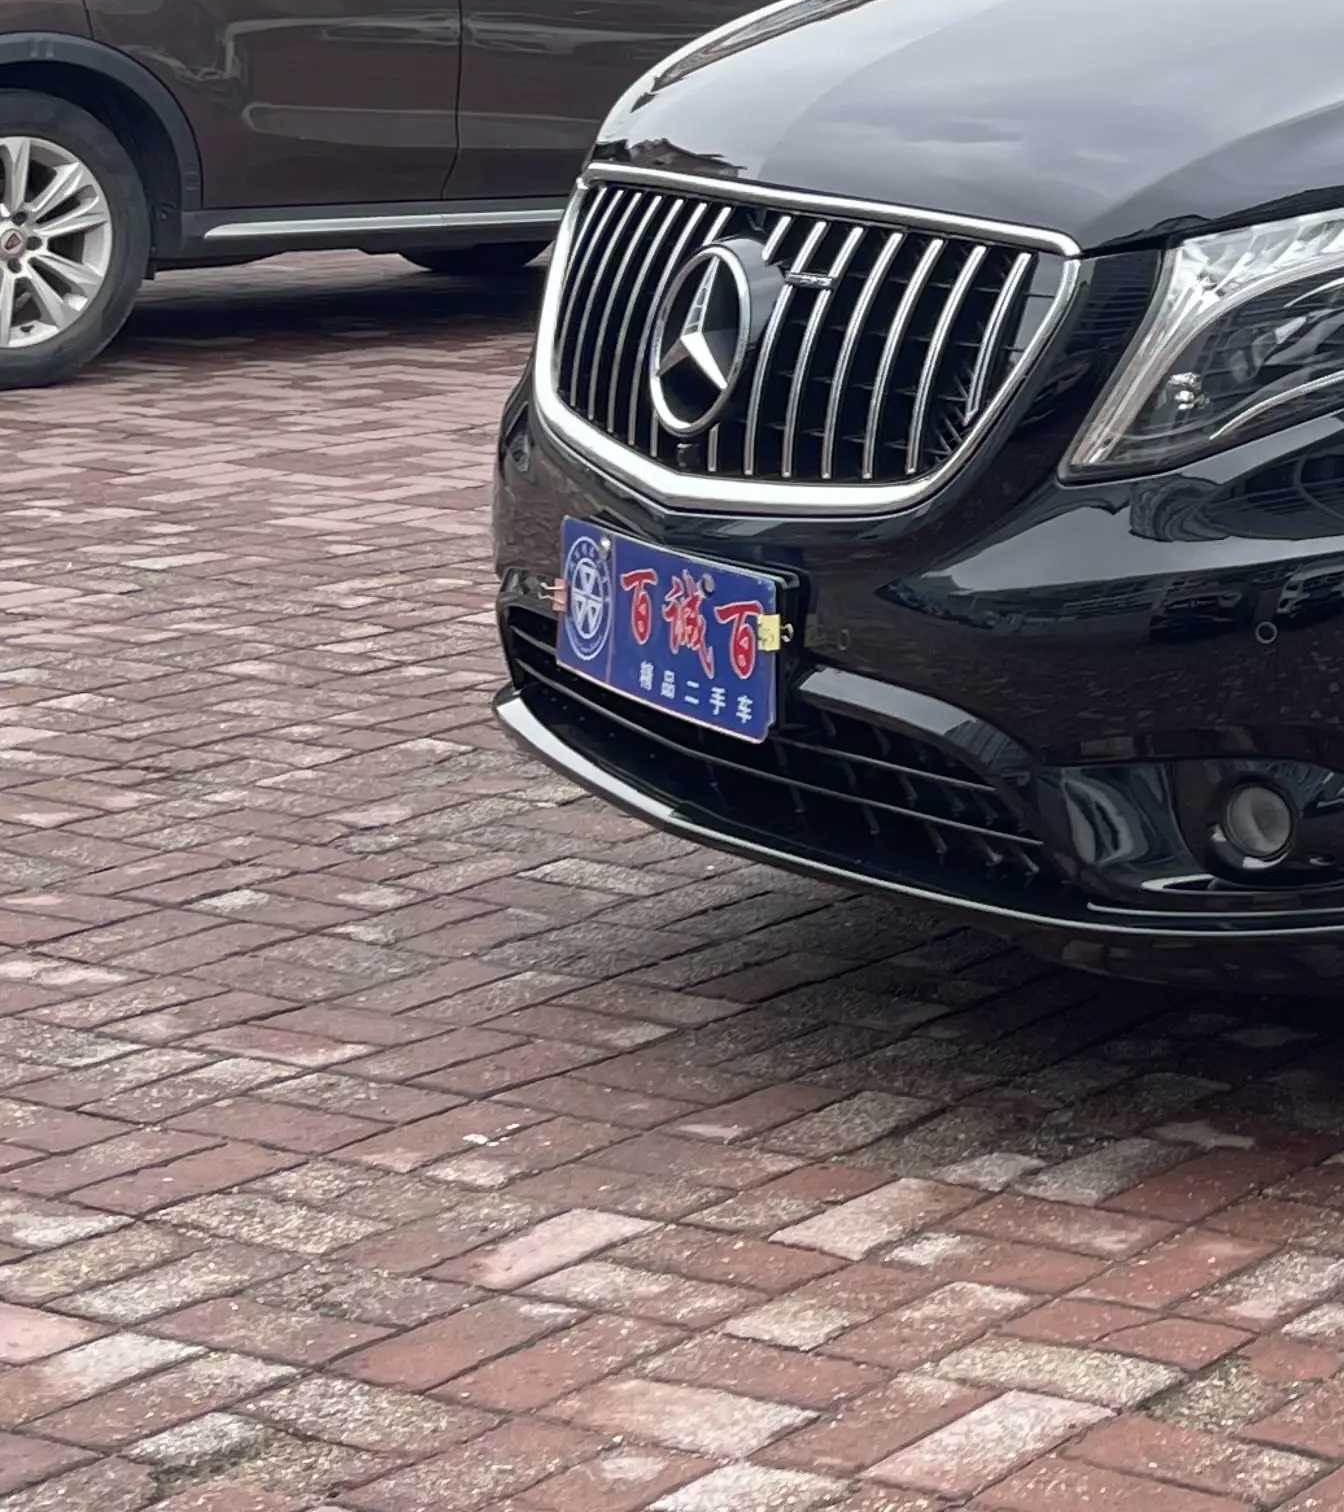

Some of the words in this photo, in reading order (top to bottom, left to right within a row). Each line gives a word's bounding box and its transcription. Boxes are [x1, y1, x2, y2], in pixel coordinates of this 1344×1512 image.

[620, 567, 764, 680] 百诚百
[638, 660, 754, 724] 精品二手车
